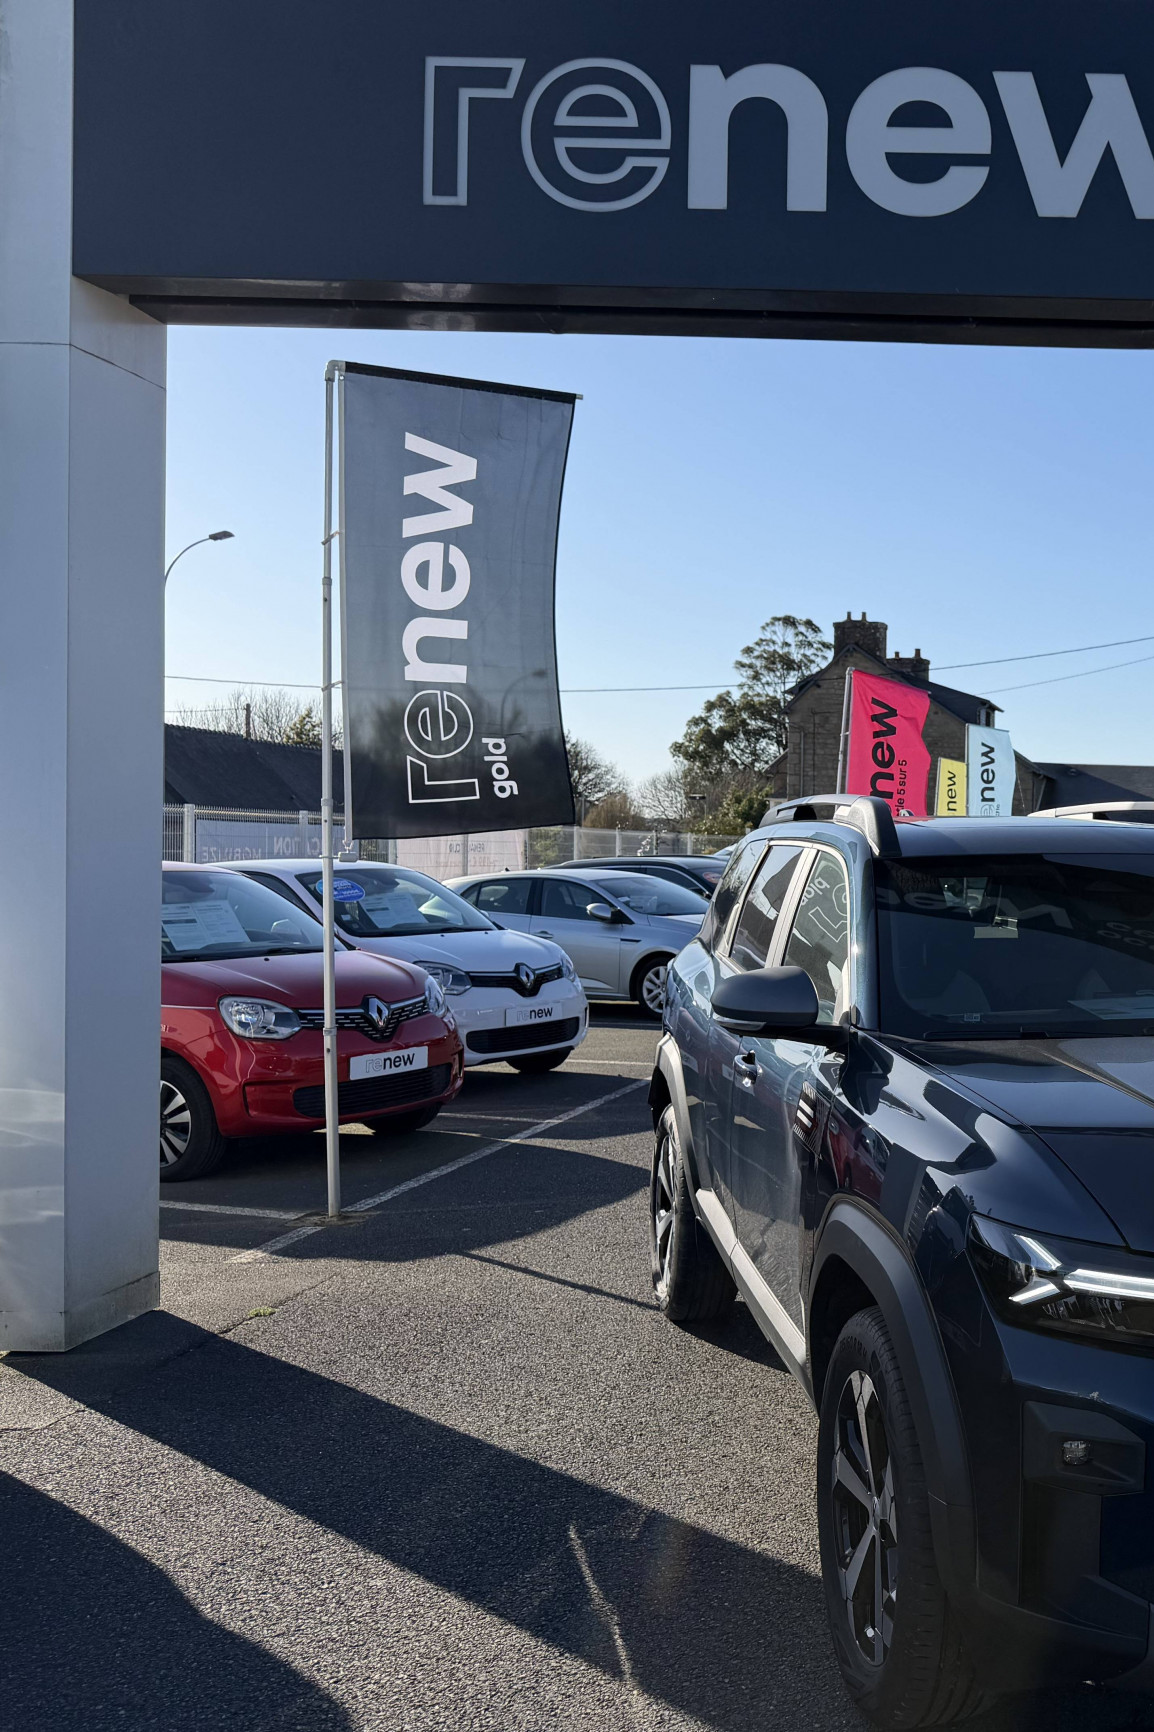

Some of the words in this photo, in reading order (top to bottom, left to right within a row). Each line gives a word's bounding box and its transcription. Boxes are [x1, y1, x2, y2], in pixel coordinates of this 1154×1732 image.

[401, 432, 480, 804] renew
[481, 737, 519, 799] gold
[870, 697, 898, 800] new
[898, 768, 908, 786] sur
[947, 770, 957, 812] new
[981, 742, 995, 816] enew
[517, 1007, 553, 1022] renew
[366, 1053, 415, 1073] renew
